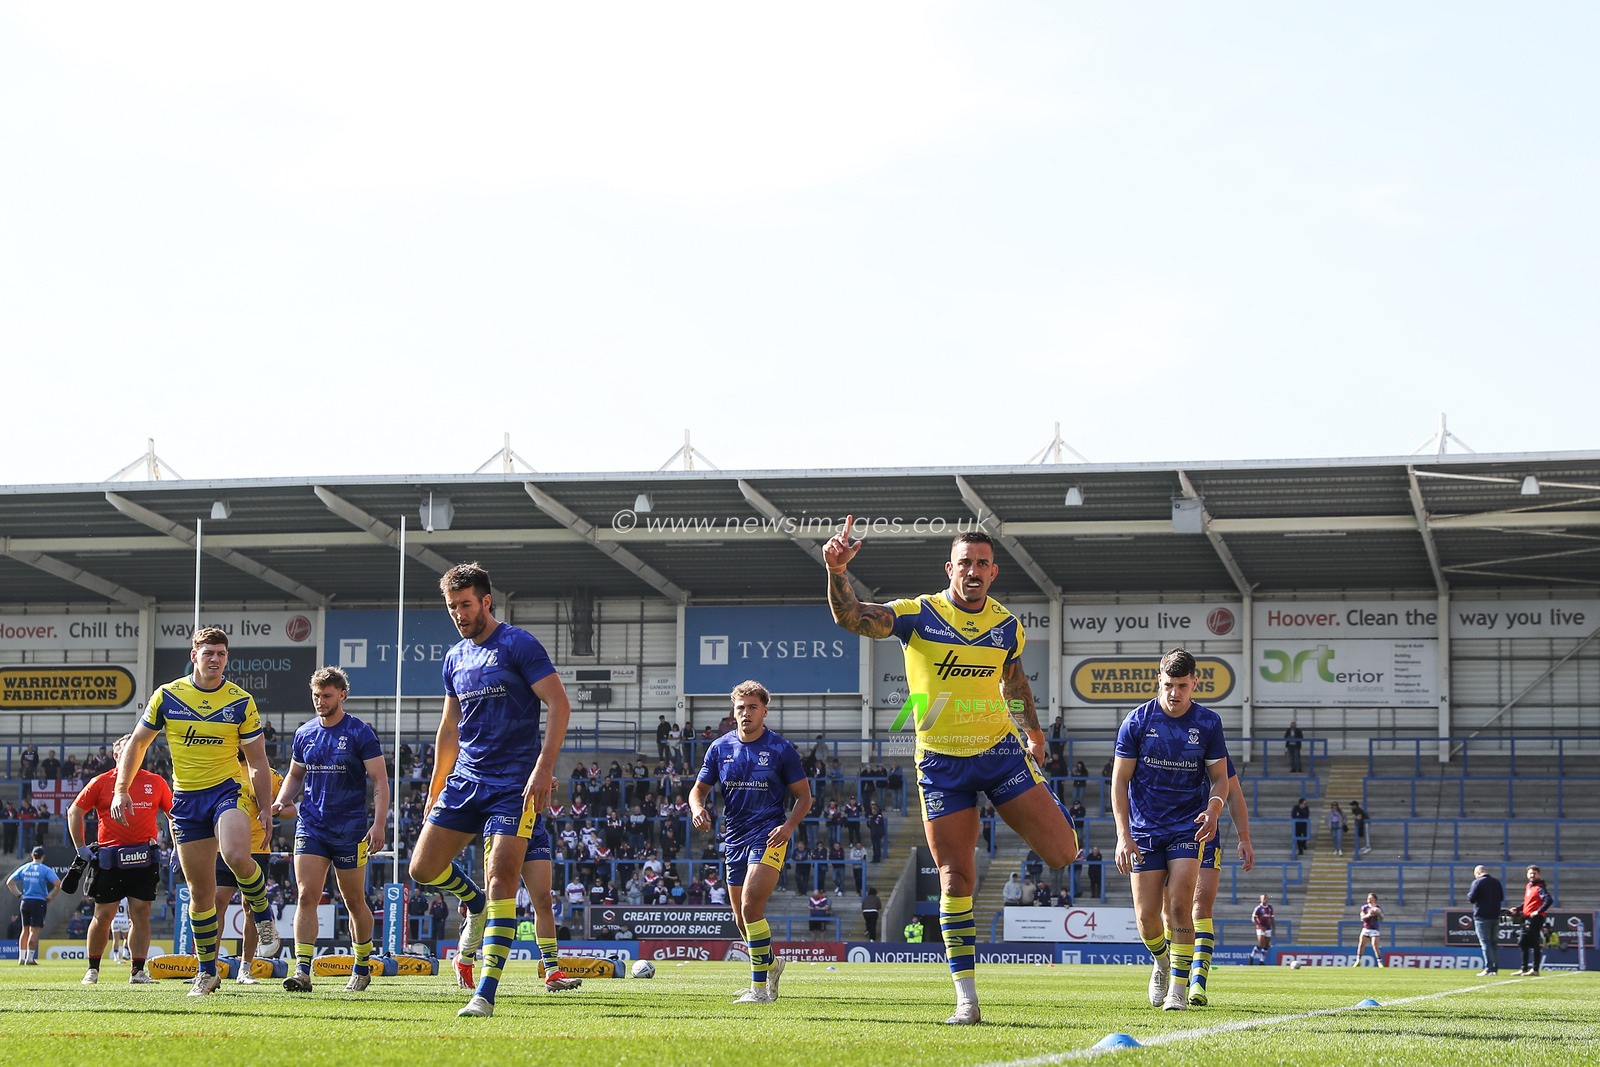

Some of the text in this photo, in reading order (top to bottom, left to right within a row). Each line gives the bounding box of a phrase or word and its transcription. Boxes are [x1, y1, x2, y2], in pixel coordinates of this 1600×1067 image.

[1020, 612, 1050, 628] the
[1070, 616, 1107, 633] way
[1115, 616, 1149, 632] you
[1158, 612, 1191, 628] live
[1268, 608, 1438, 626] Hoover. Clean the
[1460, 608, 1585, 630] way you live
[69, 622, 108, 638] Chill
[162, 624, 196, 638] way
[241, 620, 272, 636] live
[376, 644, 453, 662] TYSE
[738, 640, 844, 658] TYSERS
[1091, 668, 1214, 680] WARRINON
[4, 676, 118, 688] WARRINGTON
[1091, 682, 1215, 694] FABRICANS
[2, 689, 118, 700] FABRICATIONS
[578, 690, 592, 700] SHOT
[1151, 758, 1184, 767] Birchwood
[120, 852, 148, 861] Leuko
[622, 912, 736, 922] CREATE YOUR PERFECT
[634, 925, 721, 934] OUTDOOR SPACE
[1064, 910, 1097, 939] C4
[653, 946, 710, 960] GLEN'S
[875, 952, 947, 963] NORTHERN
[980, 953, 1052, 964] NORTHERN
[153, 962, 199, 972] ENTURION
